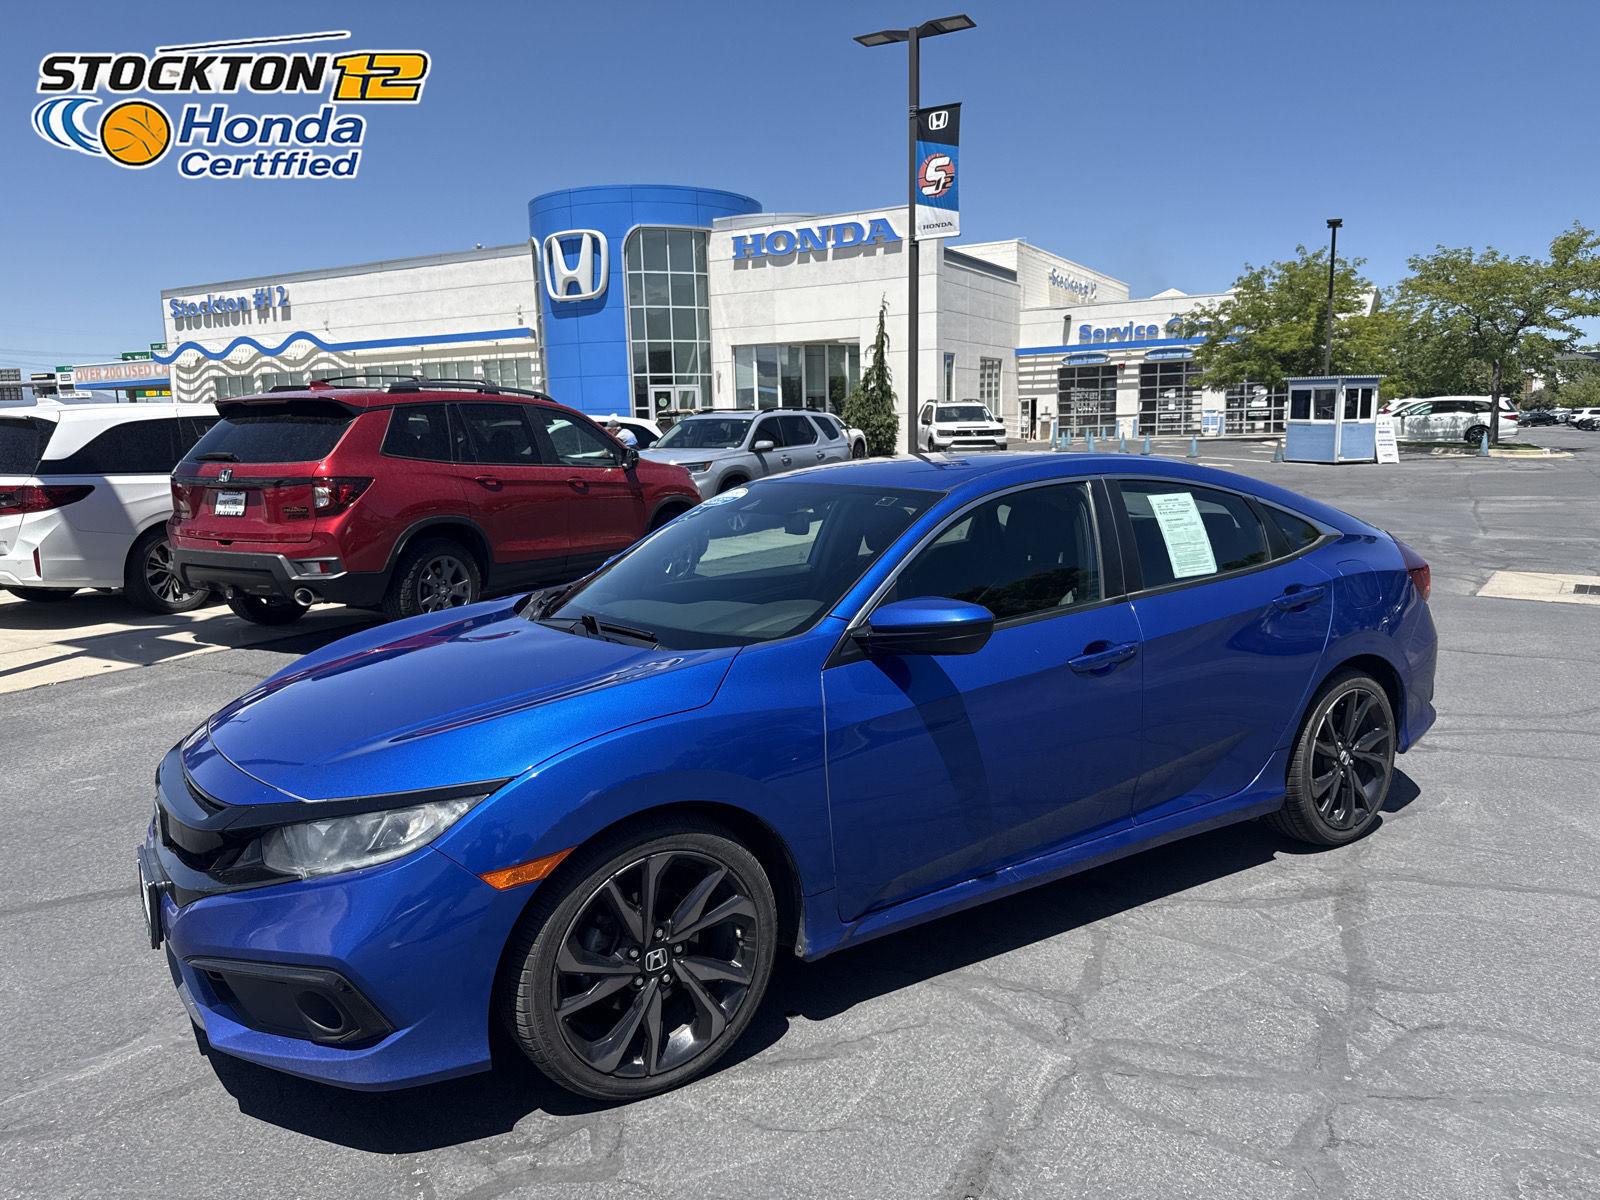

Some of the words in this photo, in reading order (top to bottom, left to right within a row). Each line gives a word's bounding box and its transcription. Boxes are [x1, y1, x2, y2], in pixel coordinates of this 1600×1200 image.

[922, 221, 953, 230] HONDA
[732, 218, 902, 260] HONDA
[170, 294, 248, 319] Stockton
[253, 285, 289, 310] #12
[1078, 321, 1160, 342] Service
[75, 367, 101, 380] OVER
[104, 366, 121, 379] 200
[124, 364, 151, 378] USED
[1250, 385, 1268, 408] 2
